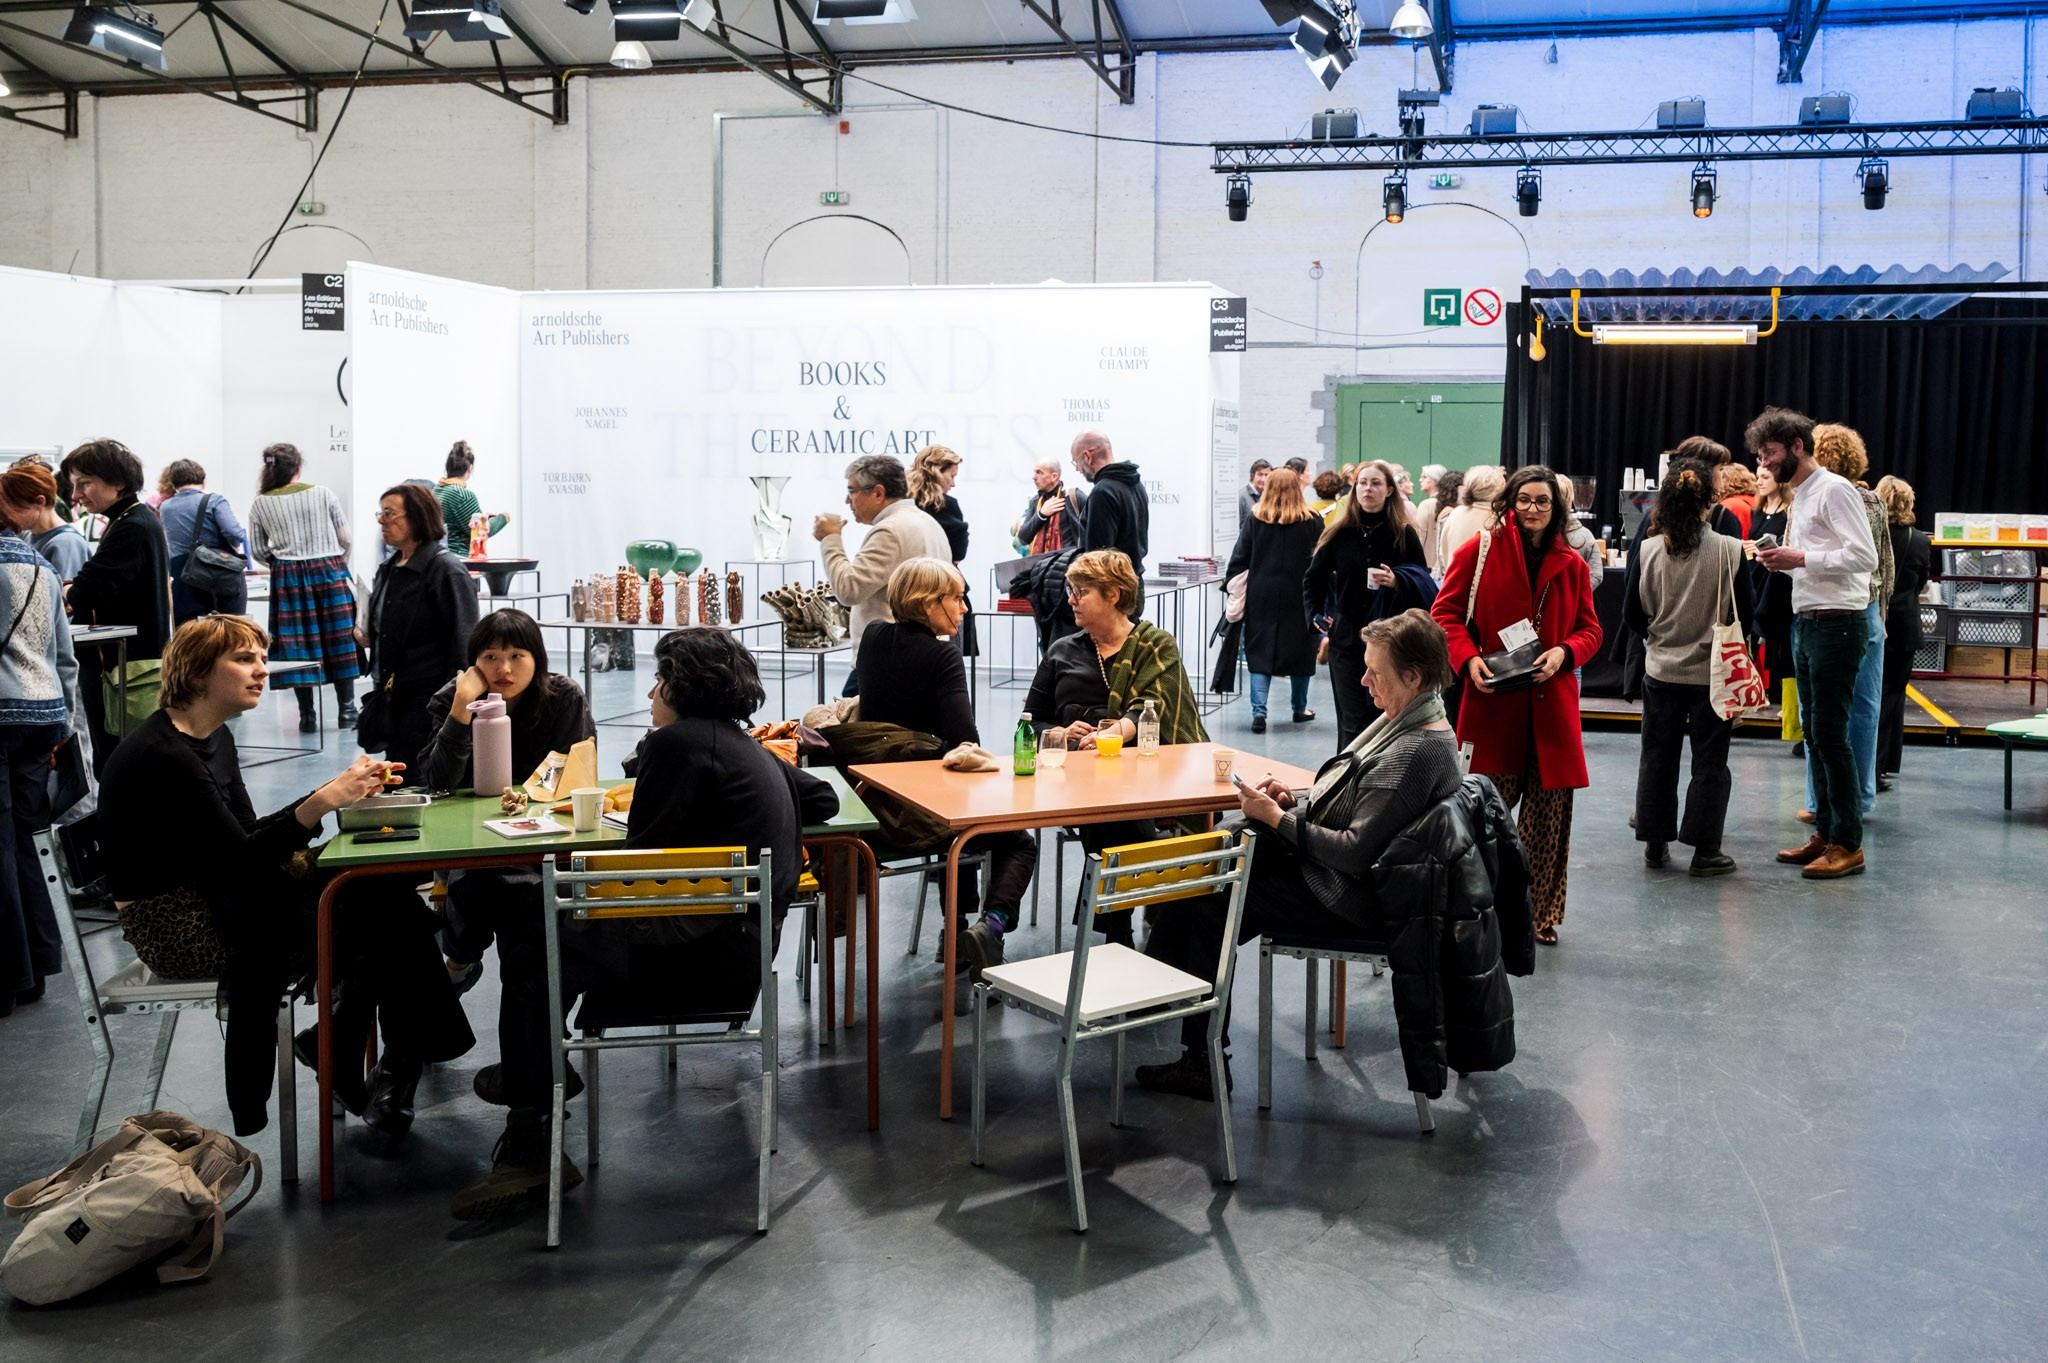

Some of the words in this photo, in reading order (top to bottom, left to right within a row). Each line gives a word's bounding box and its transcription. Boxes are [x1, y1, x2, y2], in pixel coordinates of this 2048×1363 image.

[324, 275, 343, 287] C2
[368, 290, 428, 312] arnoldsche
[1212, 299, 1229, 310] C3
[369, 308, 389, 327] Art
[394, 311, 449, 336] Publishers
[531, 310, 602, 327] arnoldsche
[533, 330, 557, 345] Art
[562, 329, 630, 345] Publishers
[1100, 346, 1149, 357] CLAUDE
[1098, 358, 1150, 370] CHAMPY
[799, 361, 886, 386] BOOKS
[833, 395, 852, 420] &
[1062, 398, 1111, 410] THOMAS
[576, 407, 628, 417] JOHANNES
[1067, 411, 1105, 422] BOHLE
[584, 419, 619, 429] NAGEL
[751, 429, 875, 454] CERAMIC
[883, 430, 936, 454] ART
[1149, 493, 1180, 504] RSEN
